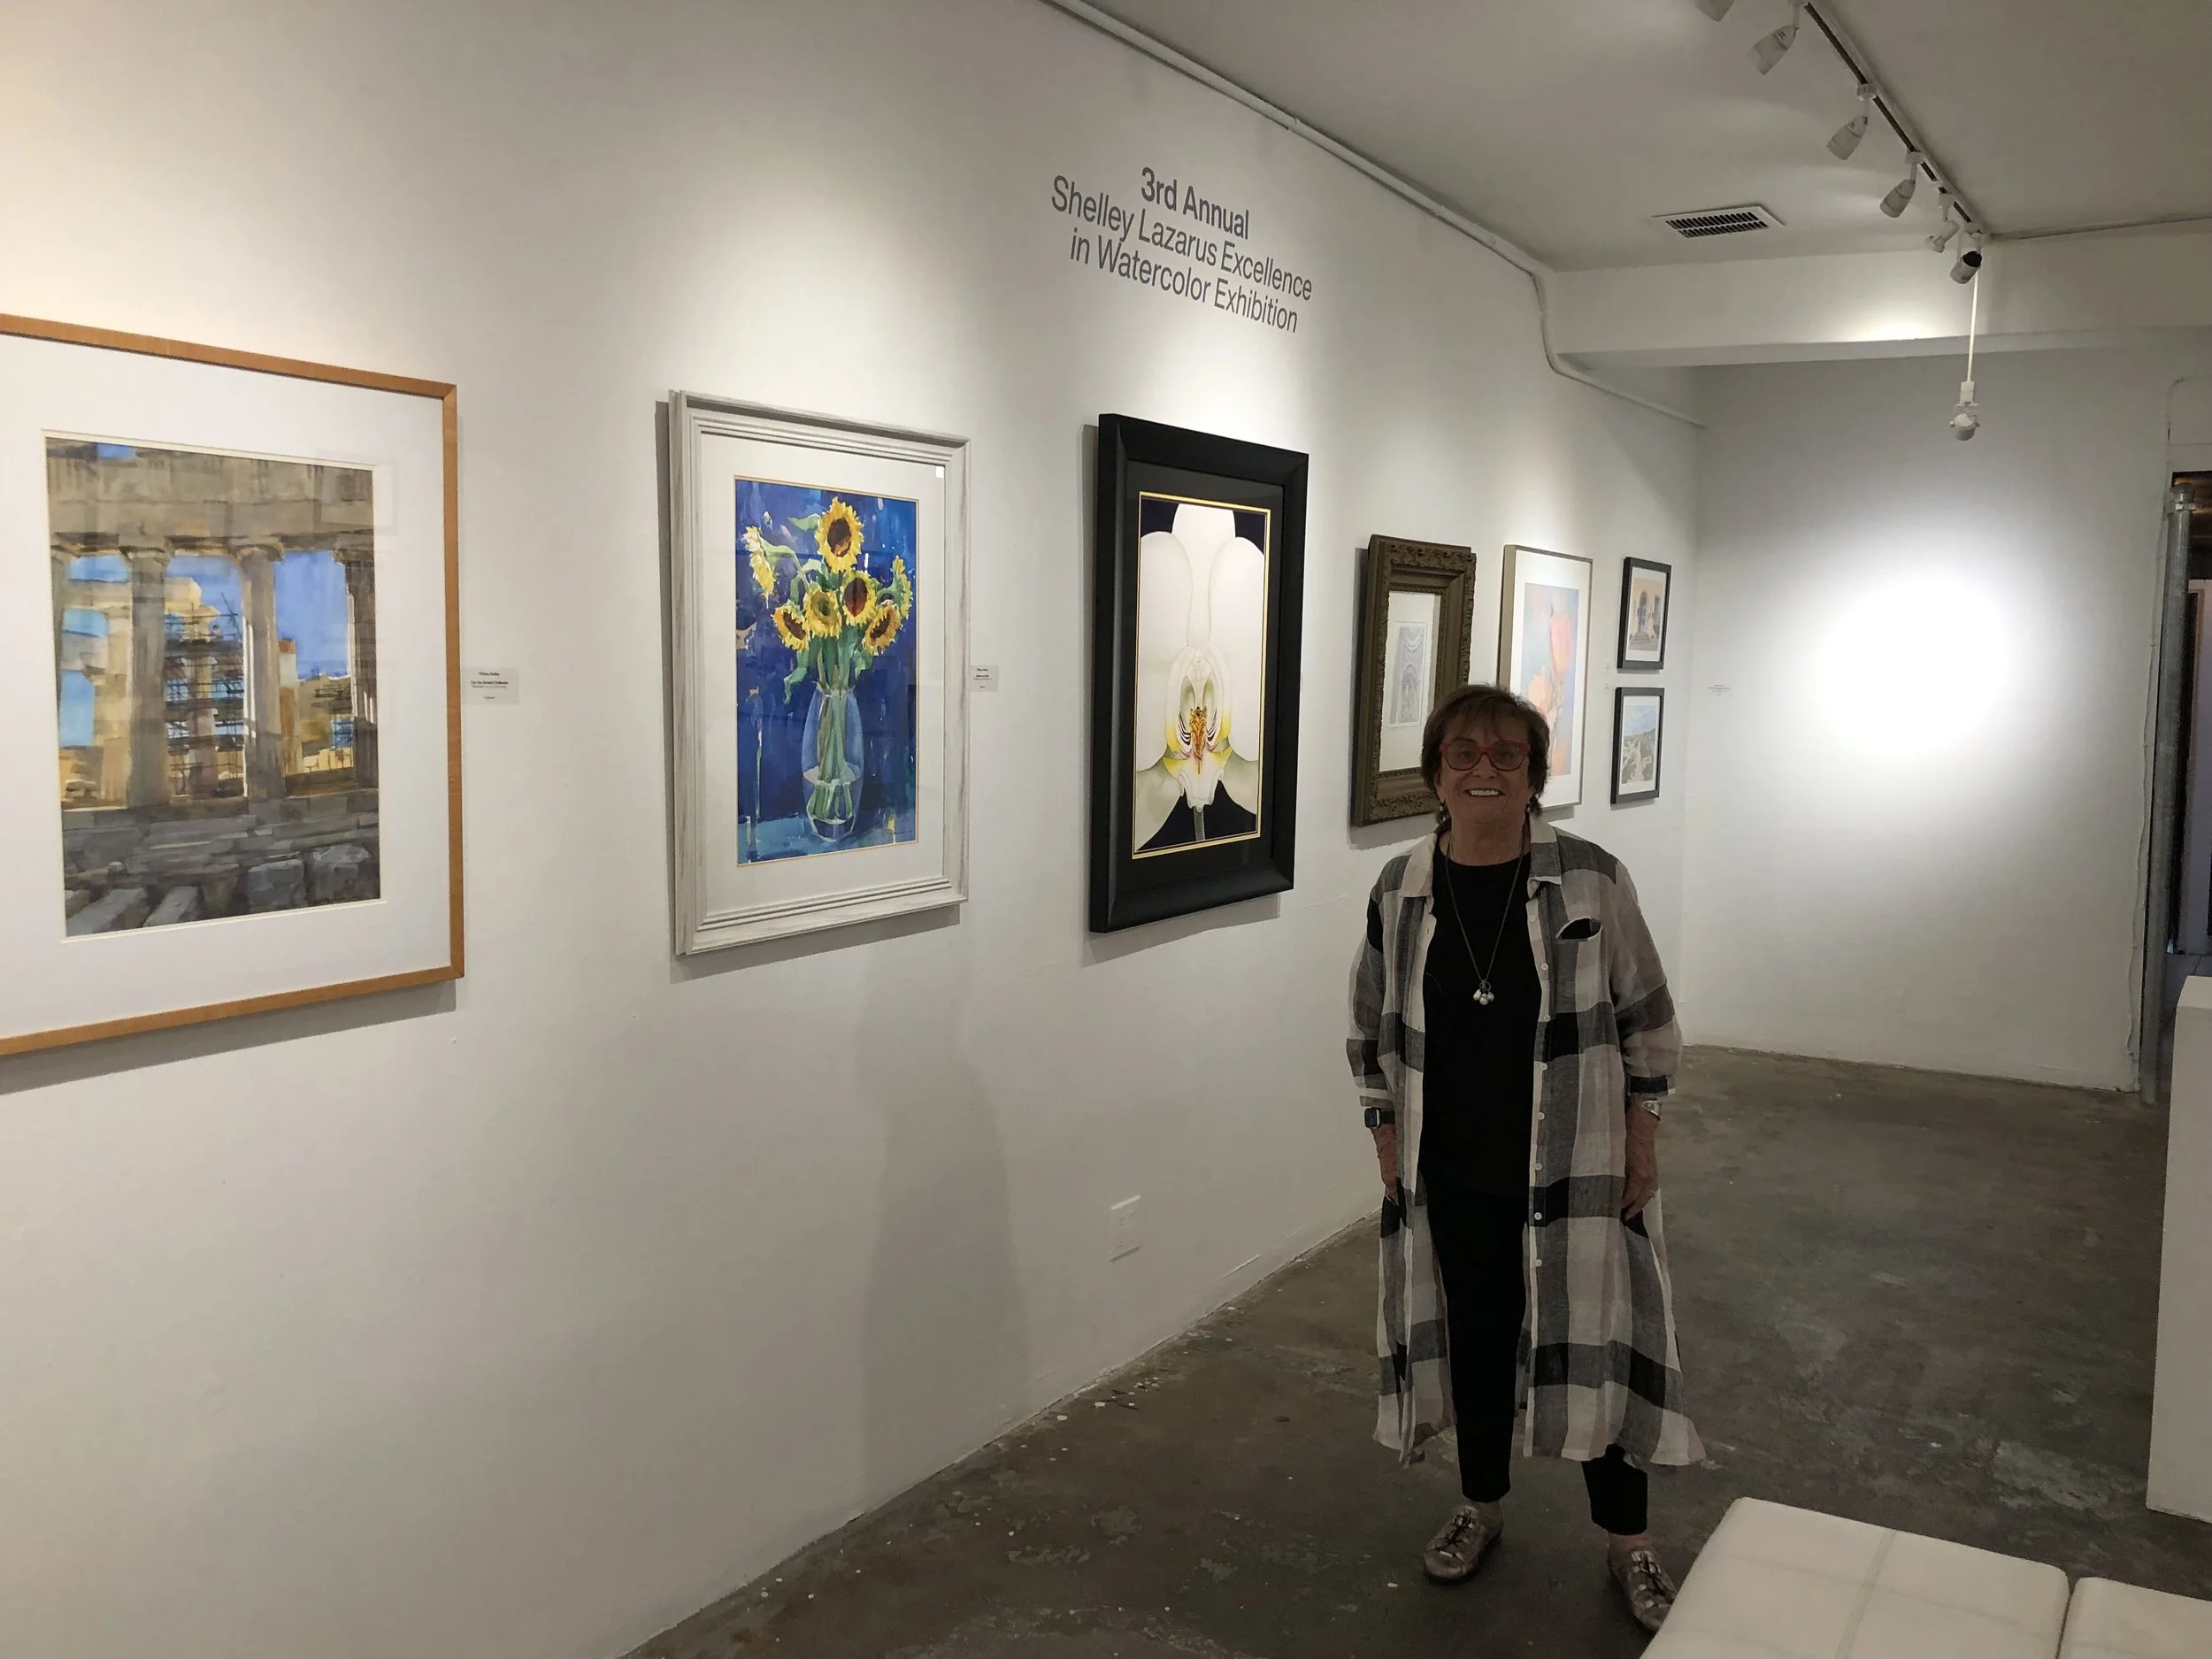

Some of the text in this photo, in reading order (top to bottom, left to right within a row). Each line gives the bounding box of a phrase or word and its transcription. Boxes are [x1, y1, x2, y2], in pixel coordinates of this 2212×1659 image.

[1051, 175, 1312, 301] Shelley Lazarus Excellence
[1141, 166, 1249, 239] 3rd Annual
[1070, 227, 1298, 333] in Watercolor Exhibition
